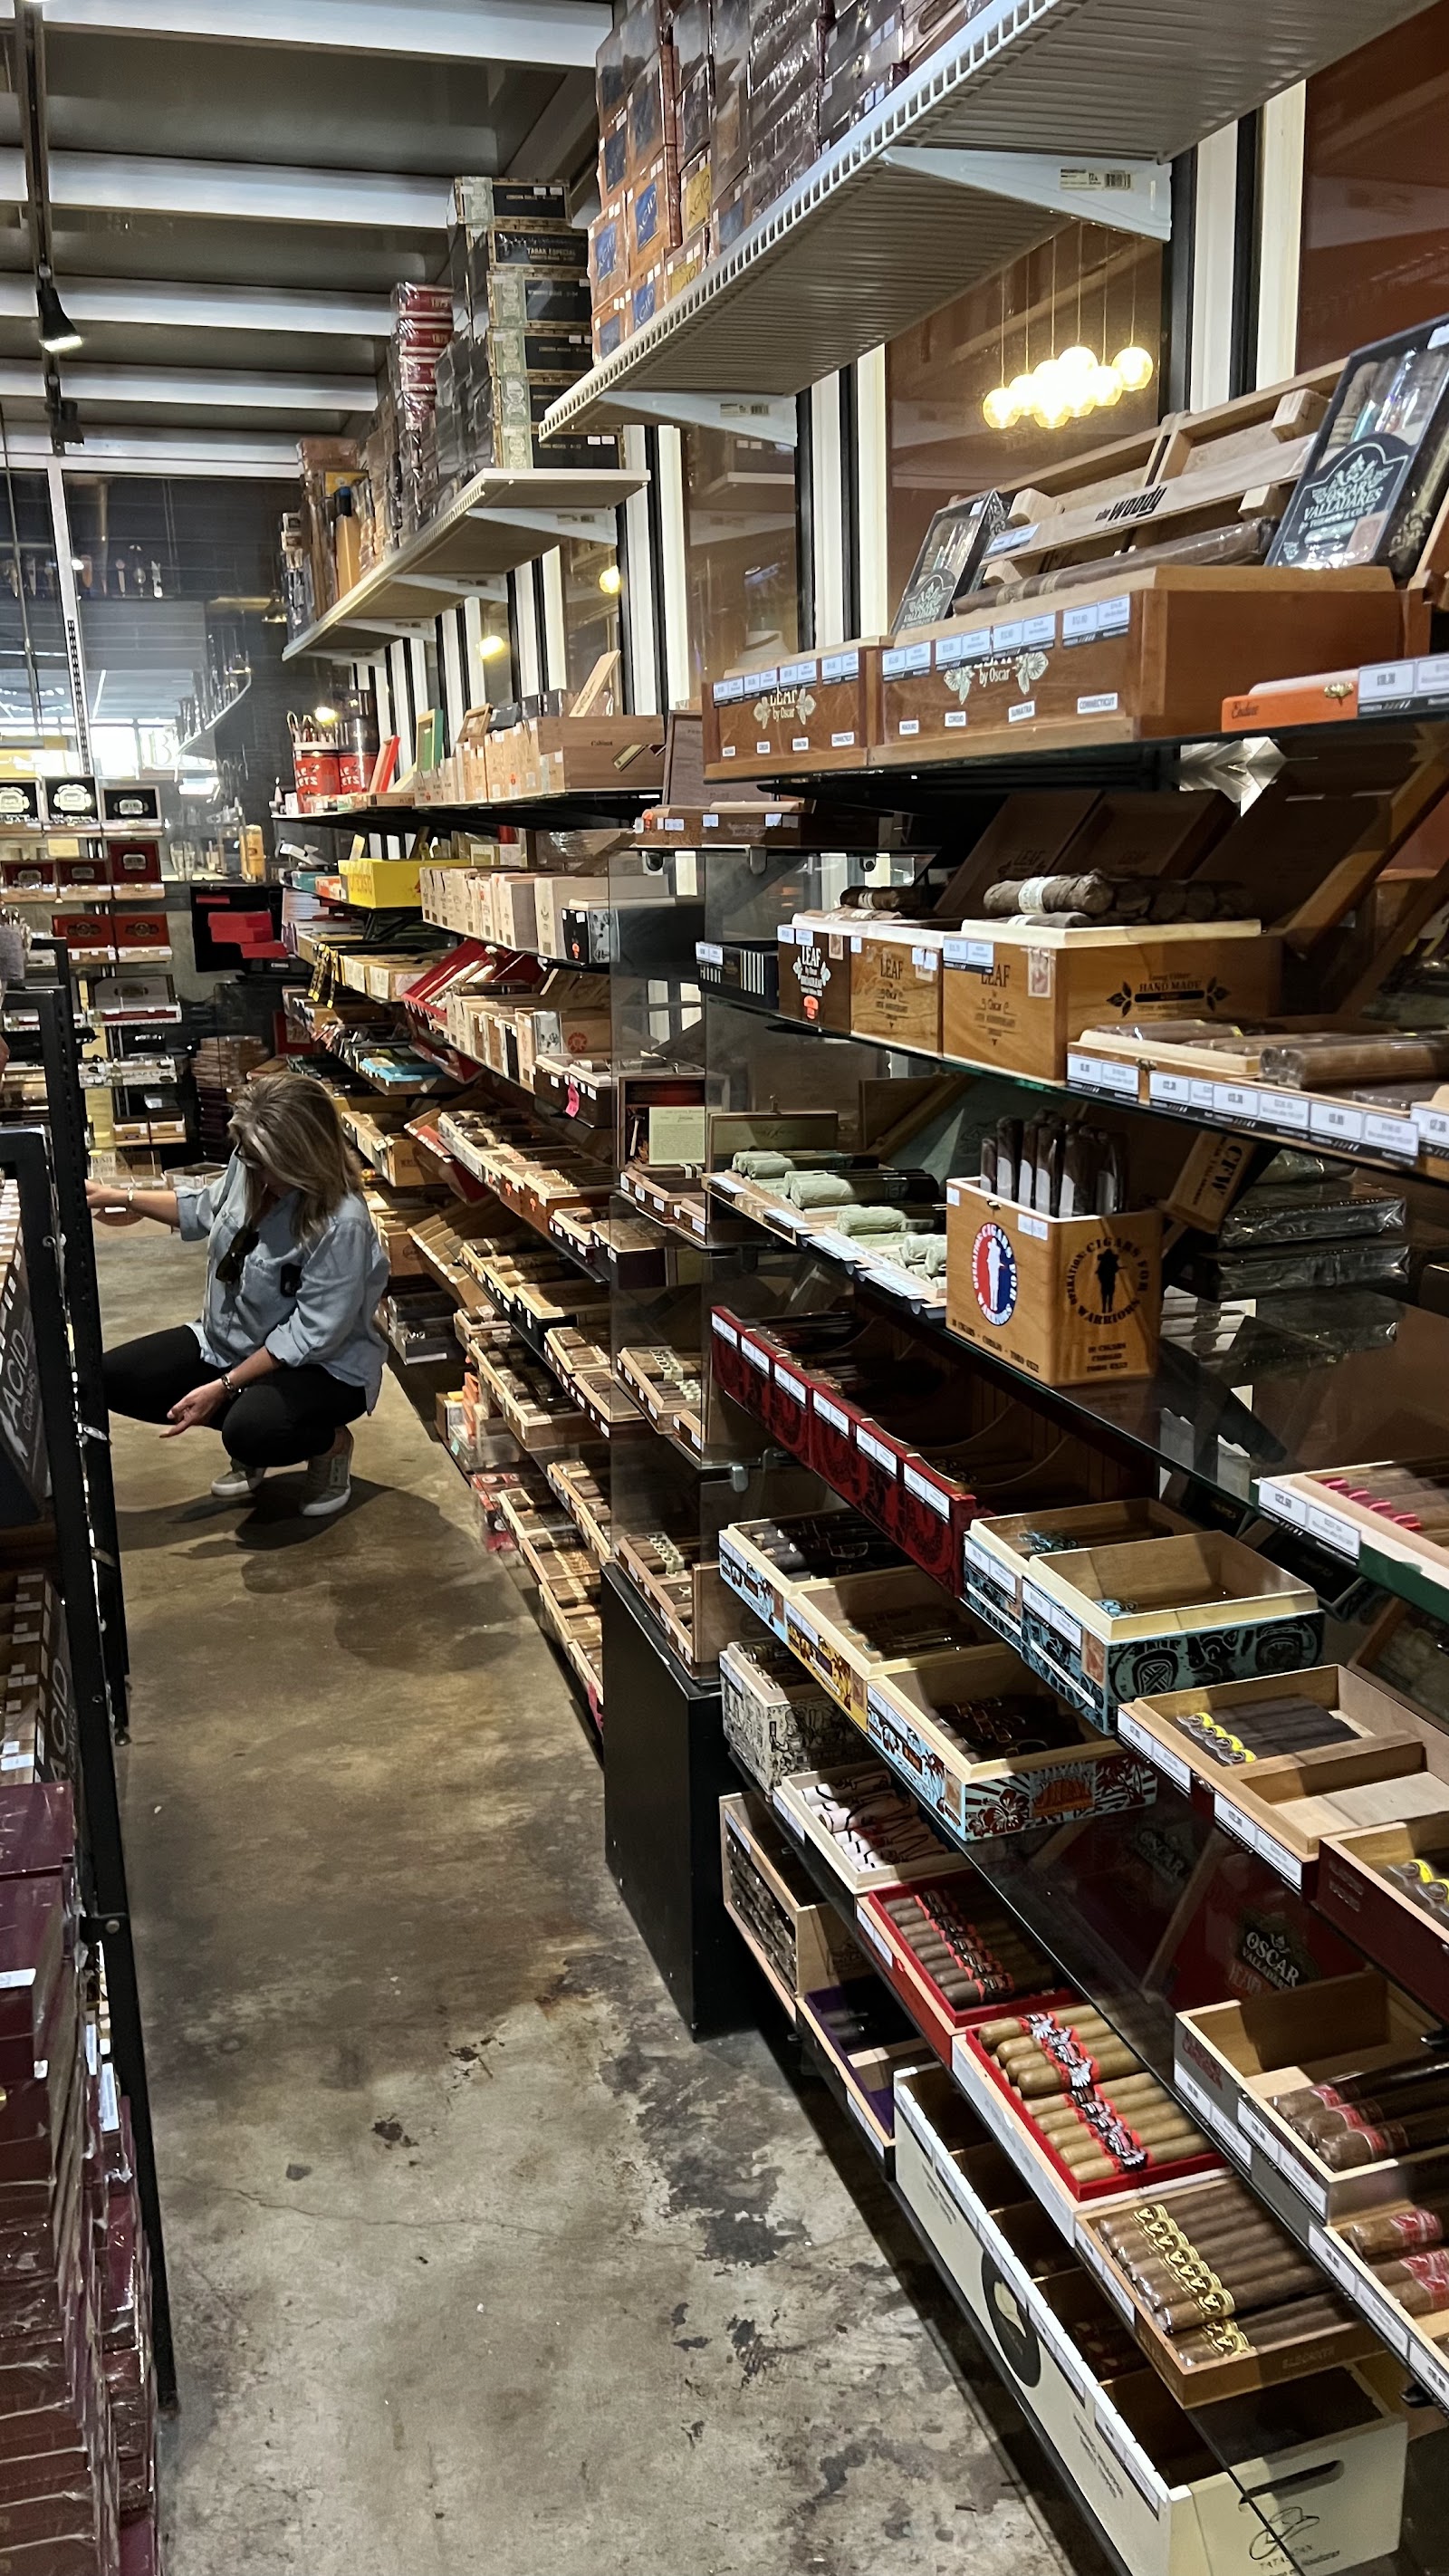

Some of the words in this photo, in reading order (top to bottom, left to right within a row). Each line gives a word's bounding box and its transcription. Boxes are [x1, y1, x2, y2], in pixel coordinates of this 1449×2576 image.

[637, 189, 657, 238] ACID
[1304, 486, 1384, 522] VALLADARES
[979, 668, 988, 687] by
[989, 667, 1011, 682] Oscar
[781, 706, 795, 719] Oscar
[1079, 697, 1116, 711] CONNECTICUT
[801, 945, 821, 967] LEAF
[879, 956, 904, 981] LEAF
[1139, 982, 1169, 993] HAND
[1171, 979, 1203, 990] MADE
[1212, 1145, 1243, 1196] CFW
[1087, 1237, 1140, 1258] CIGARS
[1078, 1297, 1141, 1325] WARRIORS
[3, 1329, 28, 1431] ACID
[49, 1658, 68, 1782] ACID
[1246, 1931, 1300, 1988] OSCAR
